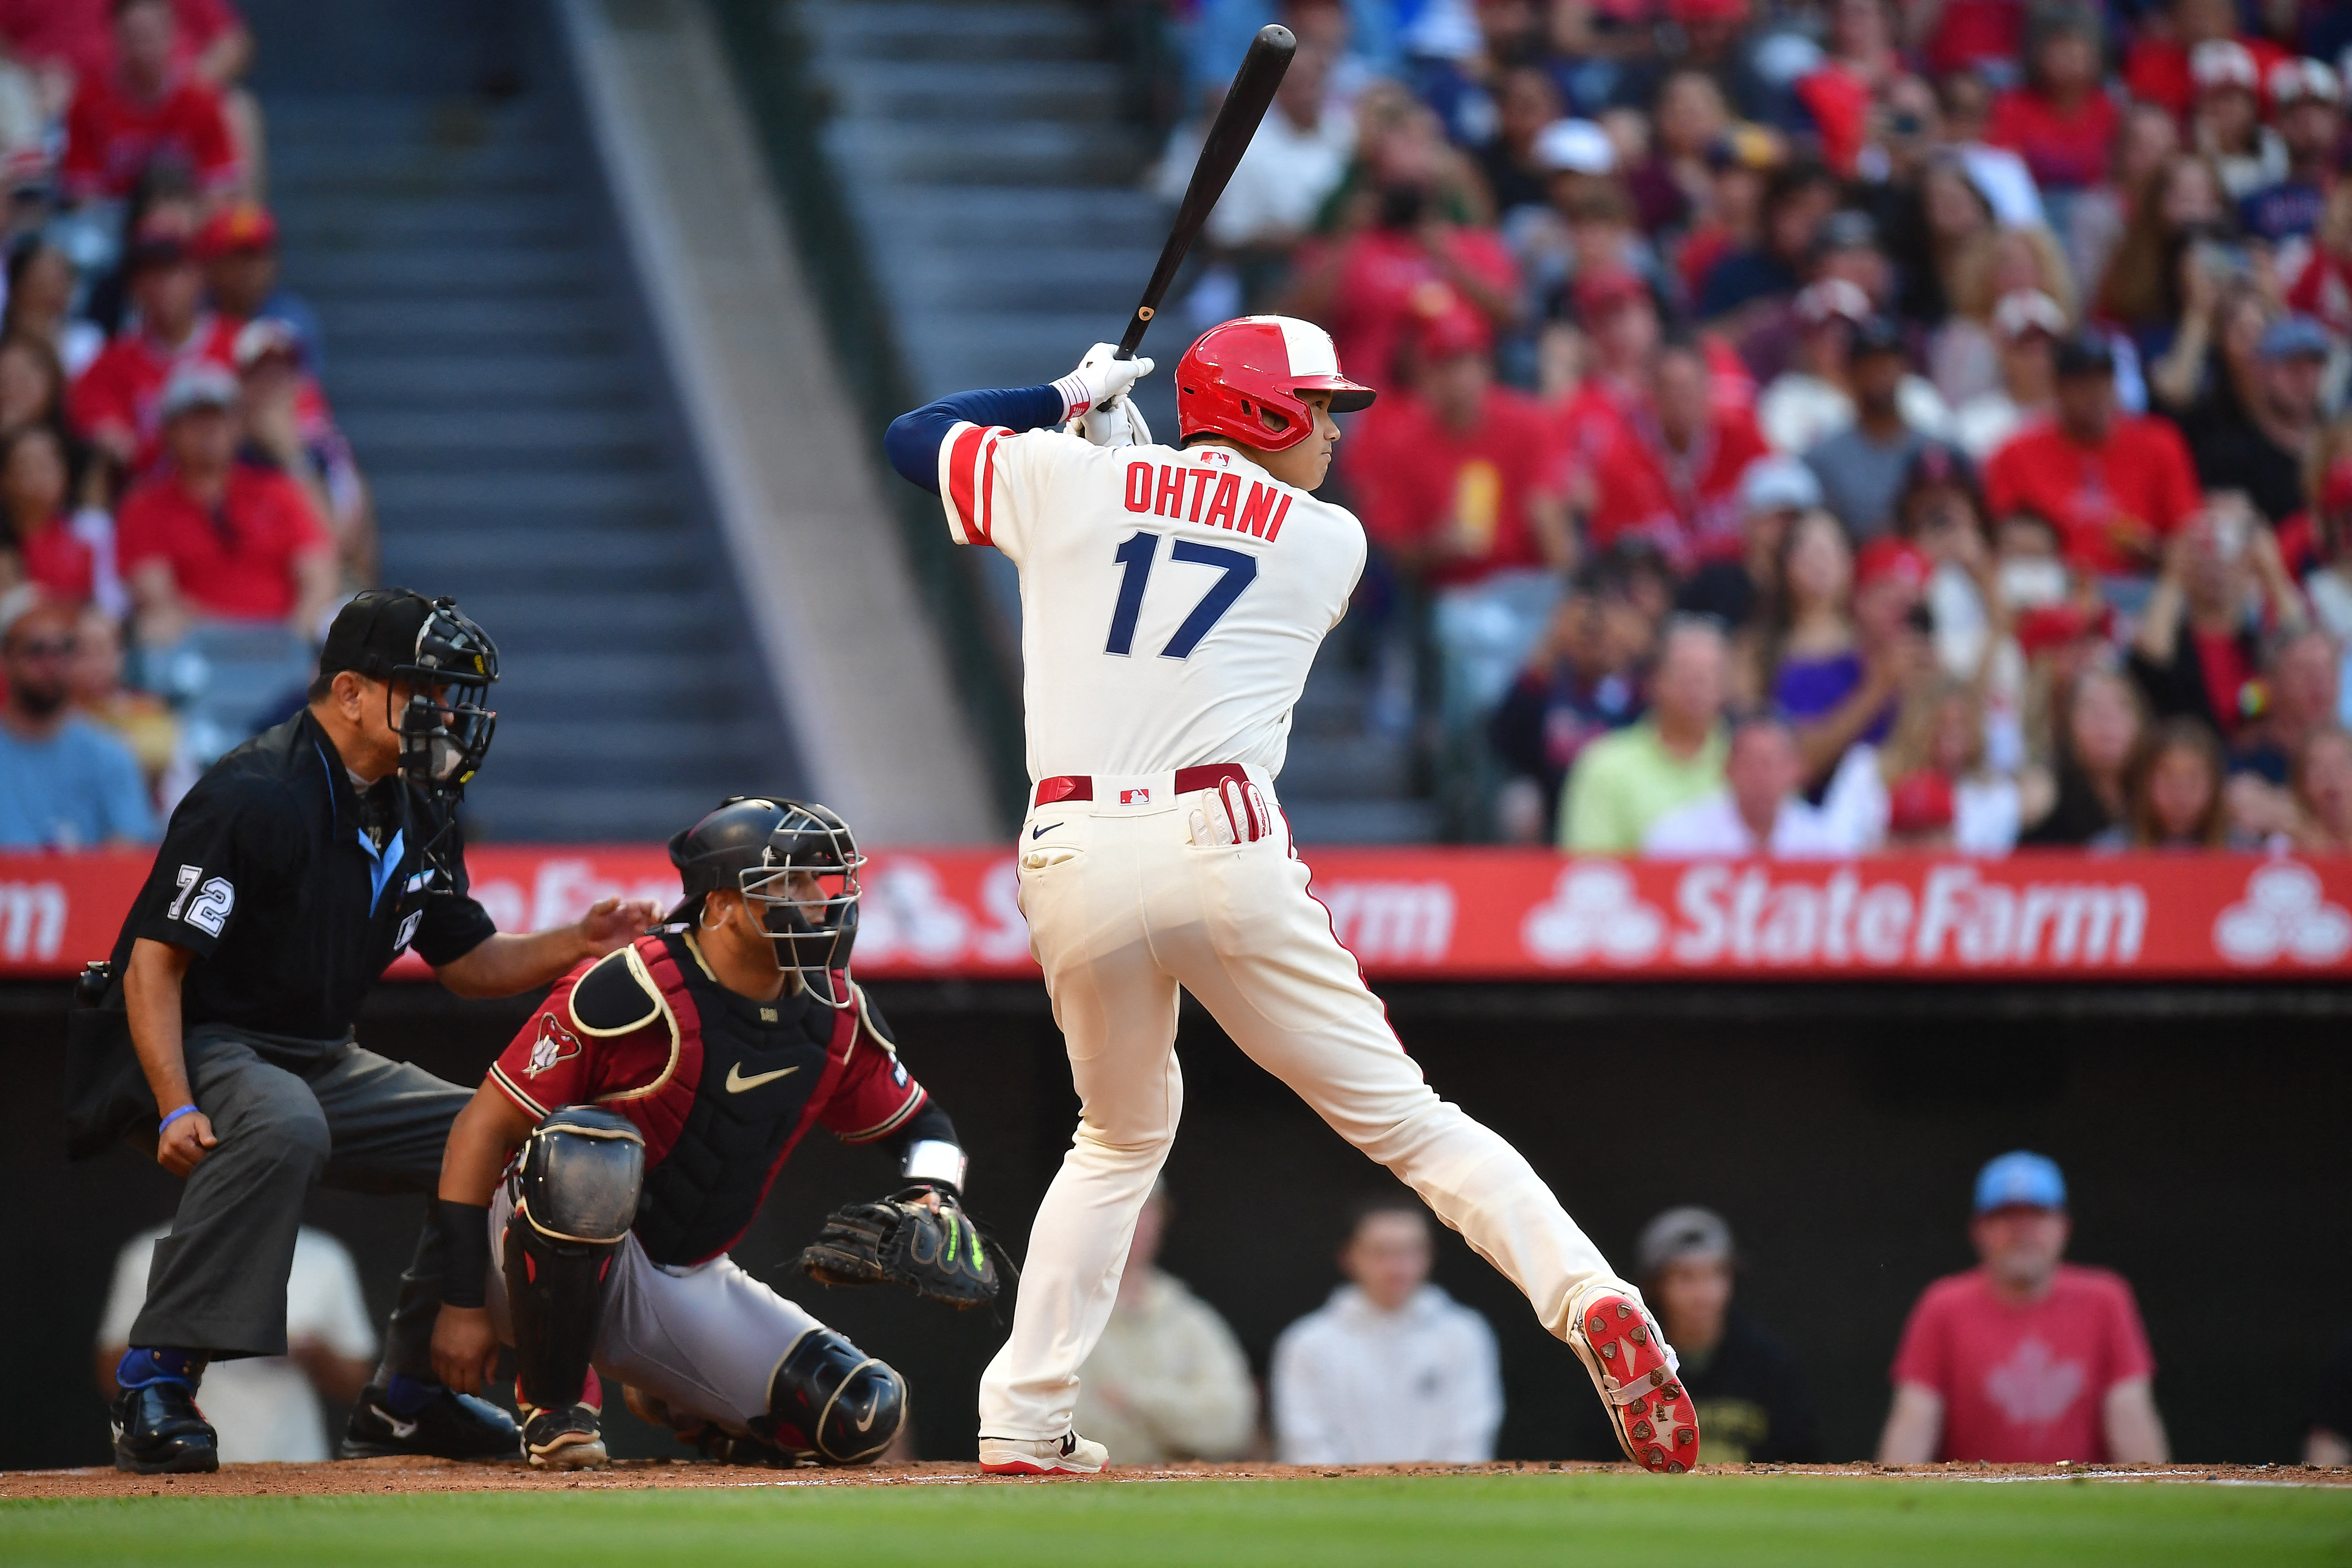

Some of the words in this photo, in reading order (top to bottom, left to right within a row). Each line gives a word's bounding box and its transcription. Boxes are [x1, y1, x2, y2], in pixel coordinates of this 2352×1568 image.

[1124, 462, 1293, 542] OHTANI
[1103, 529, 1259, 661] 17
[168, 864, 235, 938] 72
